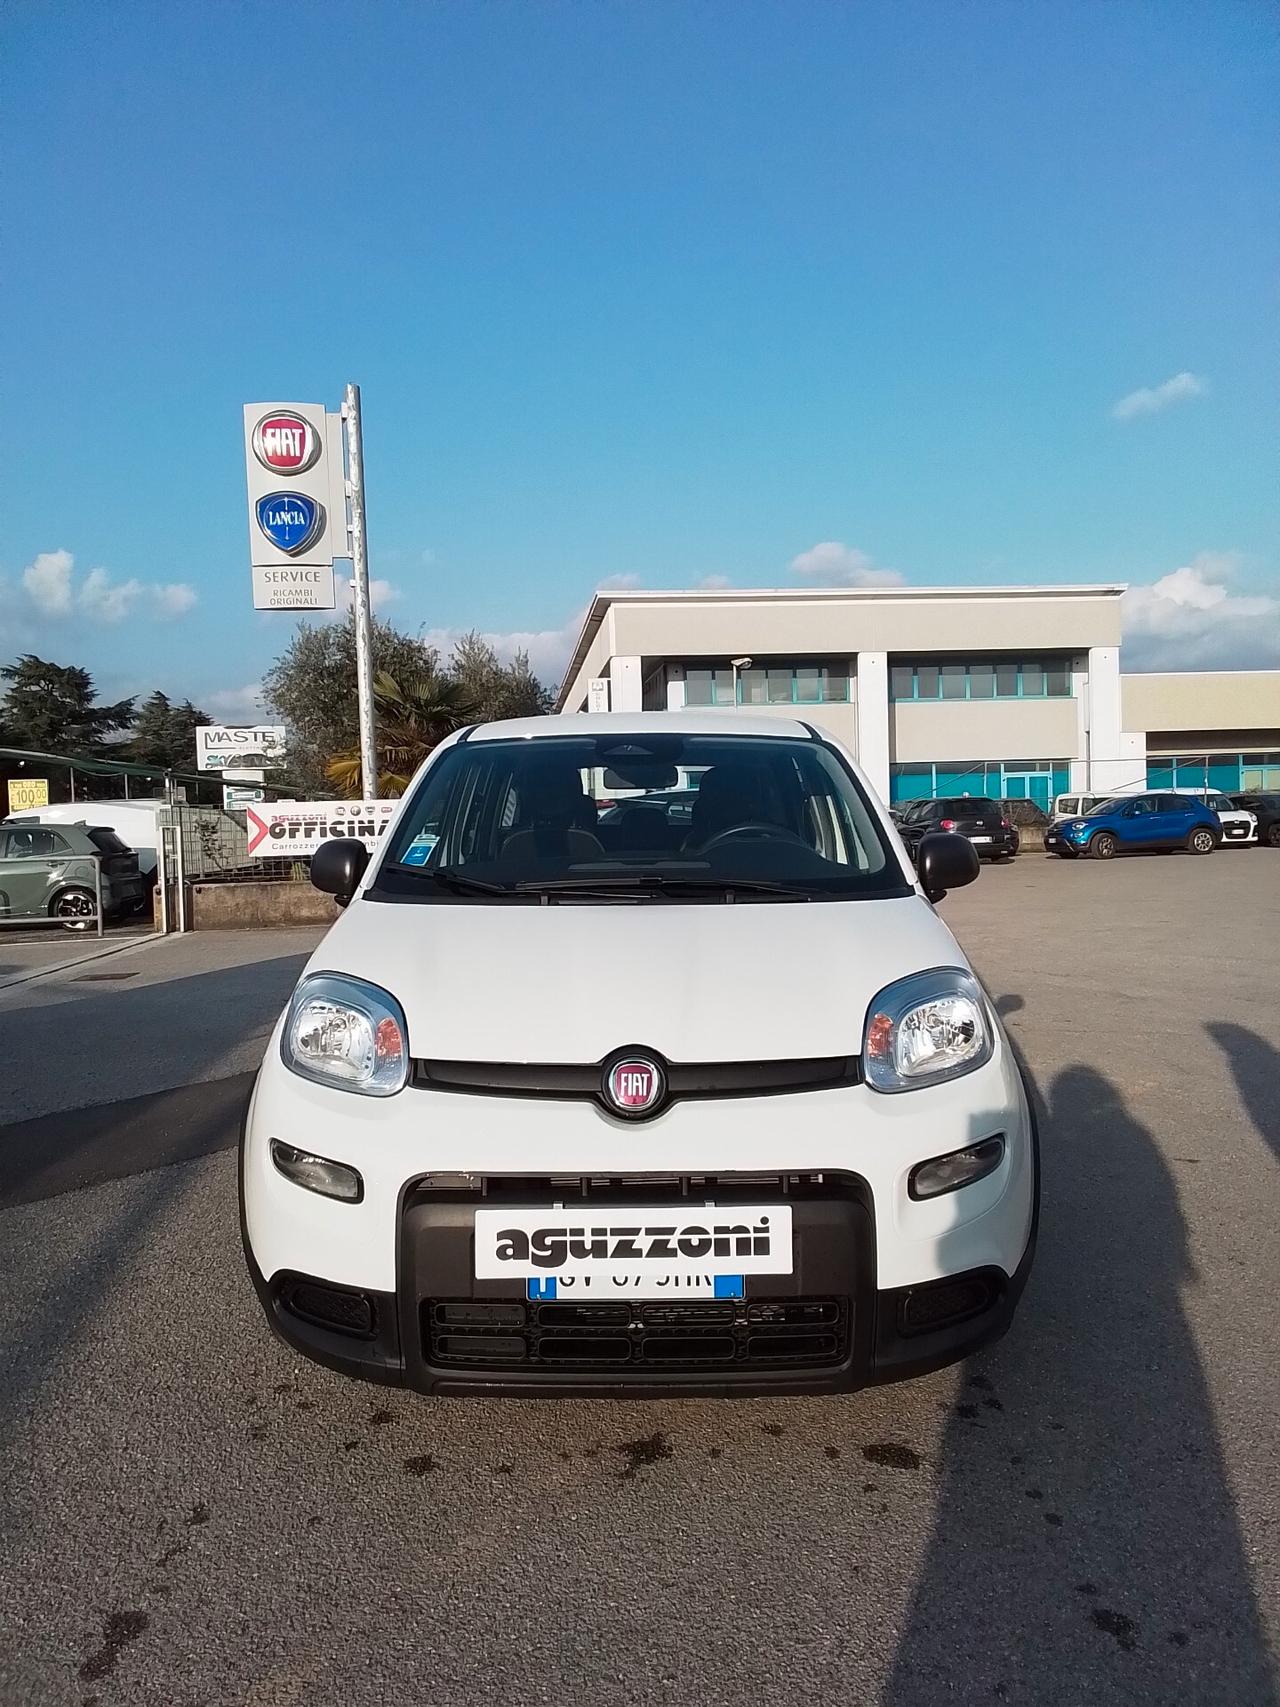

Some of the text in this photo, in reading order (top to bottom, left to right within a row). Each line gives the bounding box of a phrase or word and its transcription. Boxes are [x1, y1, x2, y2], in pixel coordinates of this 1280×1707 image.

[264, 428, 303, 457] FIAT
[268, 510, 306, 526] LANCIA
[264, 571, 321, 583] SERVICE
[273, 589, 313, 598] RICAMBI
[269, 598, 318, 606] ORIGINALI
[271, 842, 320, 850] Carrozzer
[620, 1072, 650, 1097] FIAT
[495, 1215, 771, 1269] aguzzoni
